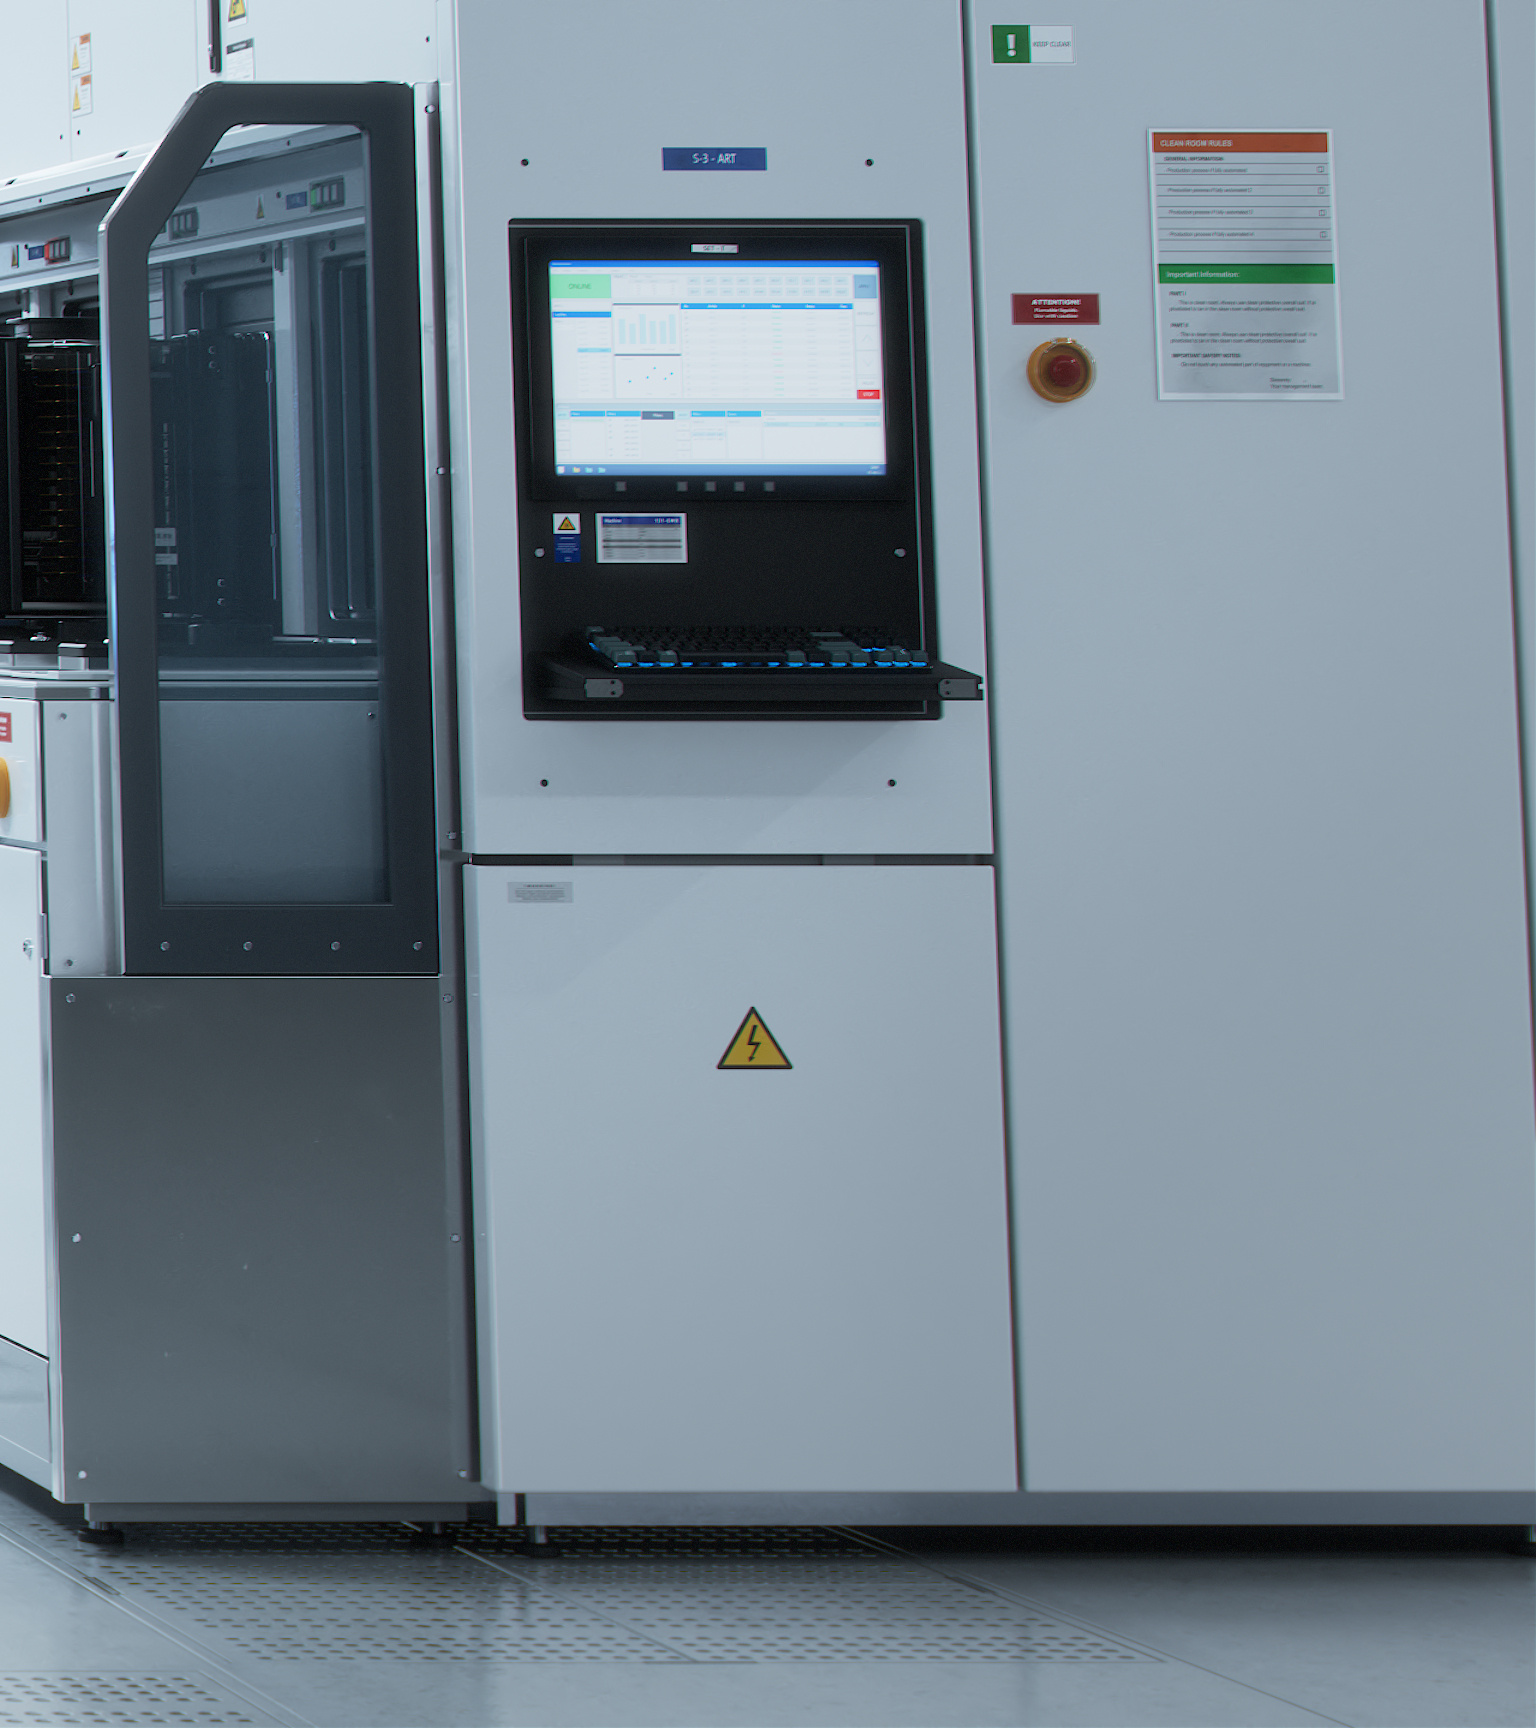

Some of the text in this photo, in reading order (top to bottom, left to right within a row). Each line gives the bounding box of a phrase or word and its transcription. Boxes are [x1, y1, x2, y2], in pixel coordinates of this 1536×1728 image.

[1159, 139, 1233, 147] CLEAN ROOM RULES
[692, 153, 709, 164] S-3
[716, 153, 737, 164] ART
[1031, 298, 1081, 306] ATTENTION!
